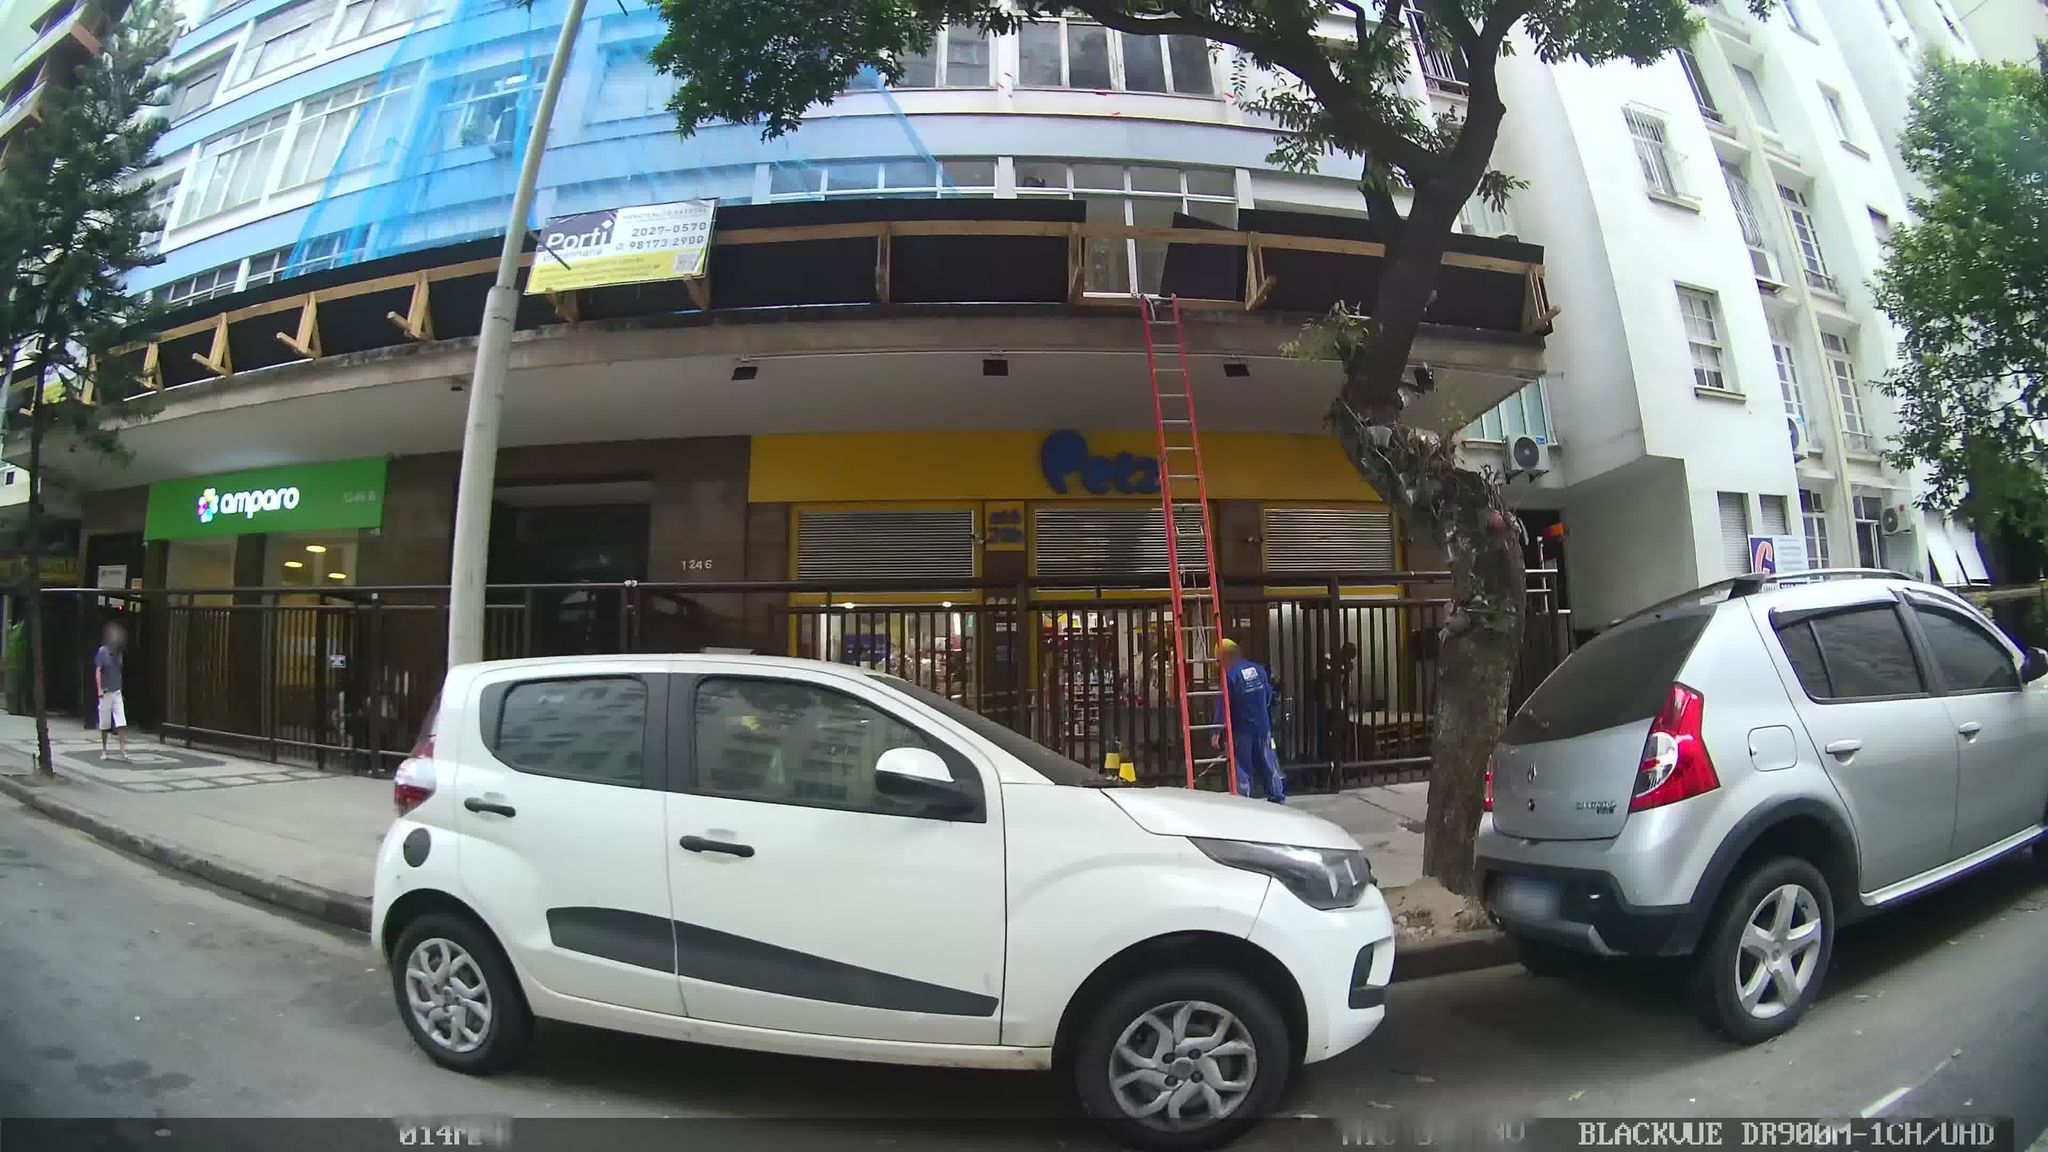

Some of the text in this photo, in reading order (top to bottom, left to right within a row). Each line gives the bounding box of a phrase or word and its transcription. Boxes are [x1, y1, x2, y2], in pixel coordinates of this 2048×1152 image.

[545, 220, 614, 250] Porti
[631, 222, 707, 237] 2027-0570
[629, 235, 704, 250] 98173 2900
[220, 487, 300, 519] amparo
[681, 559, 713, 571] 1246
